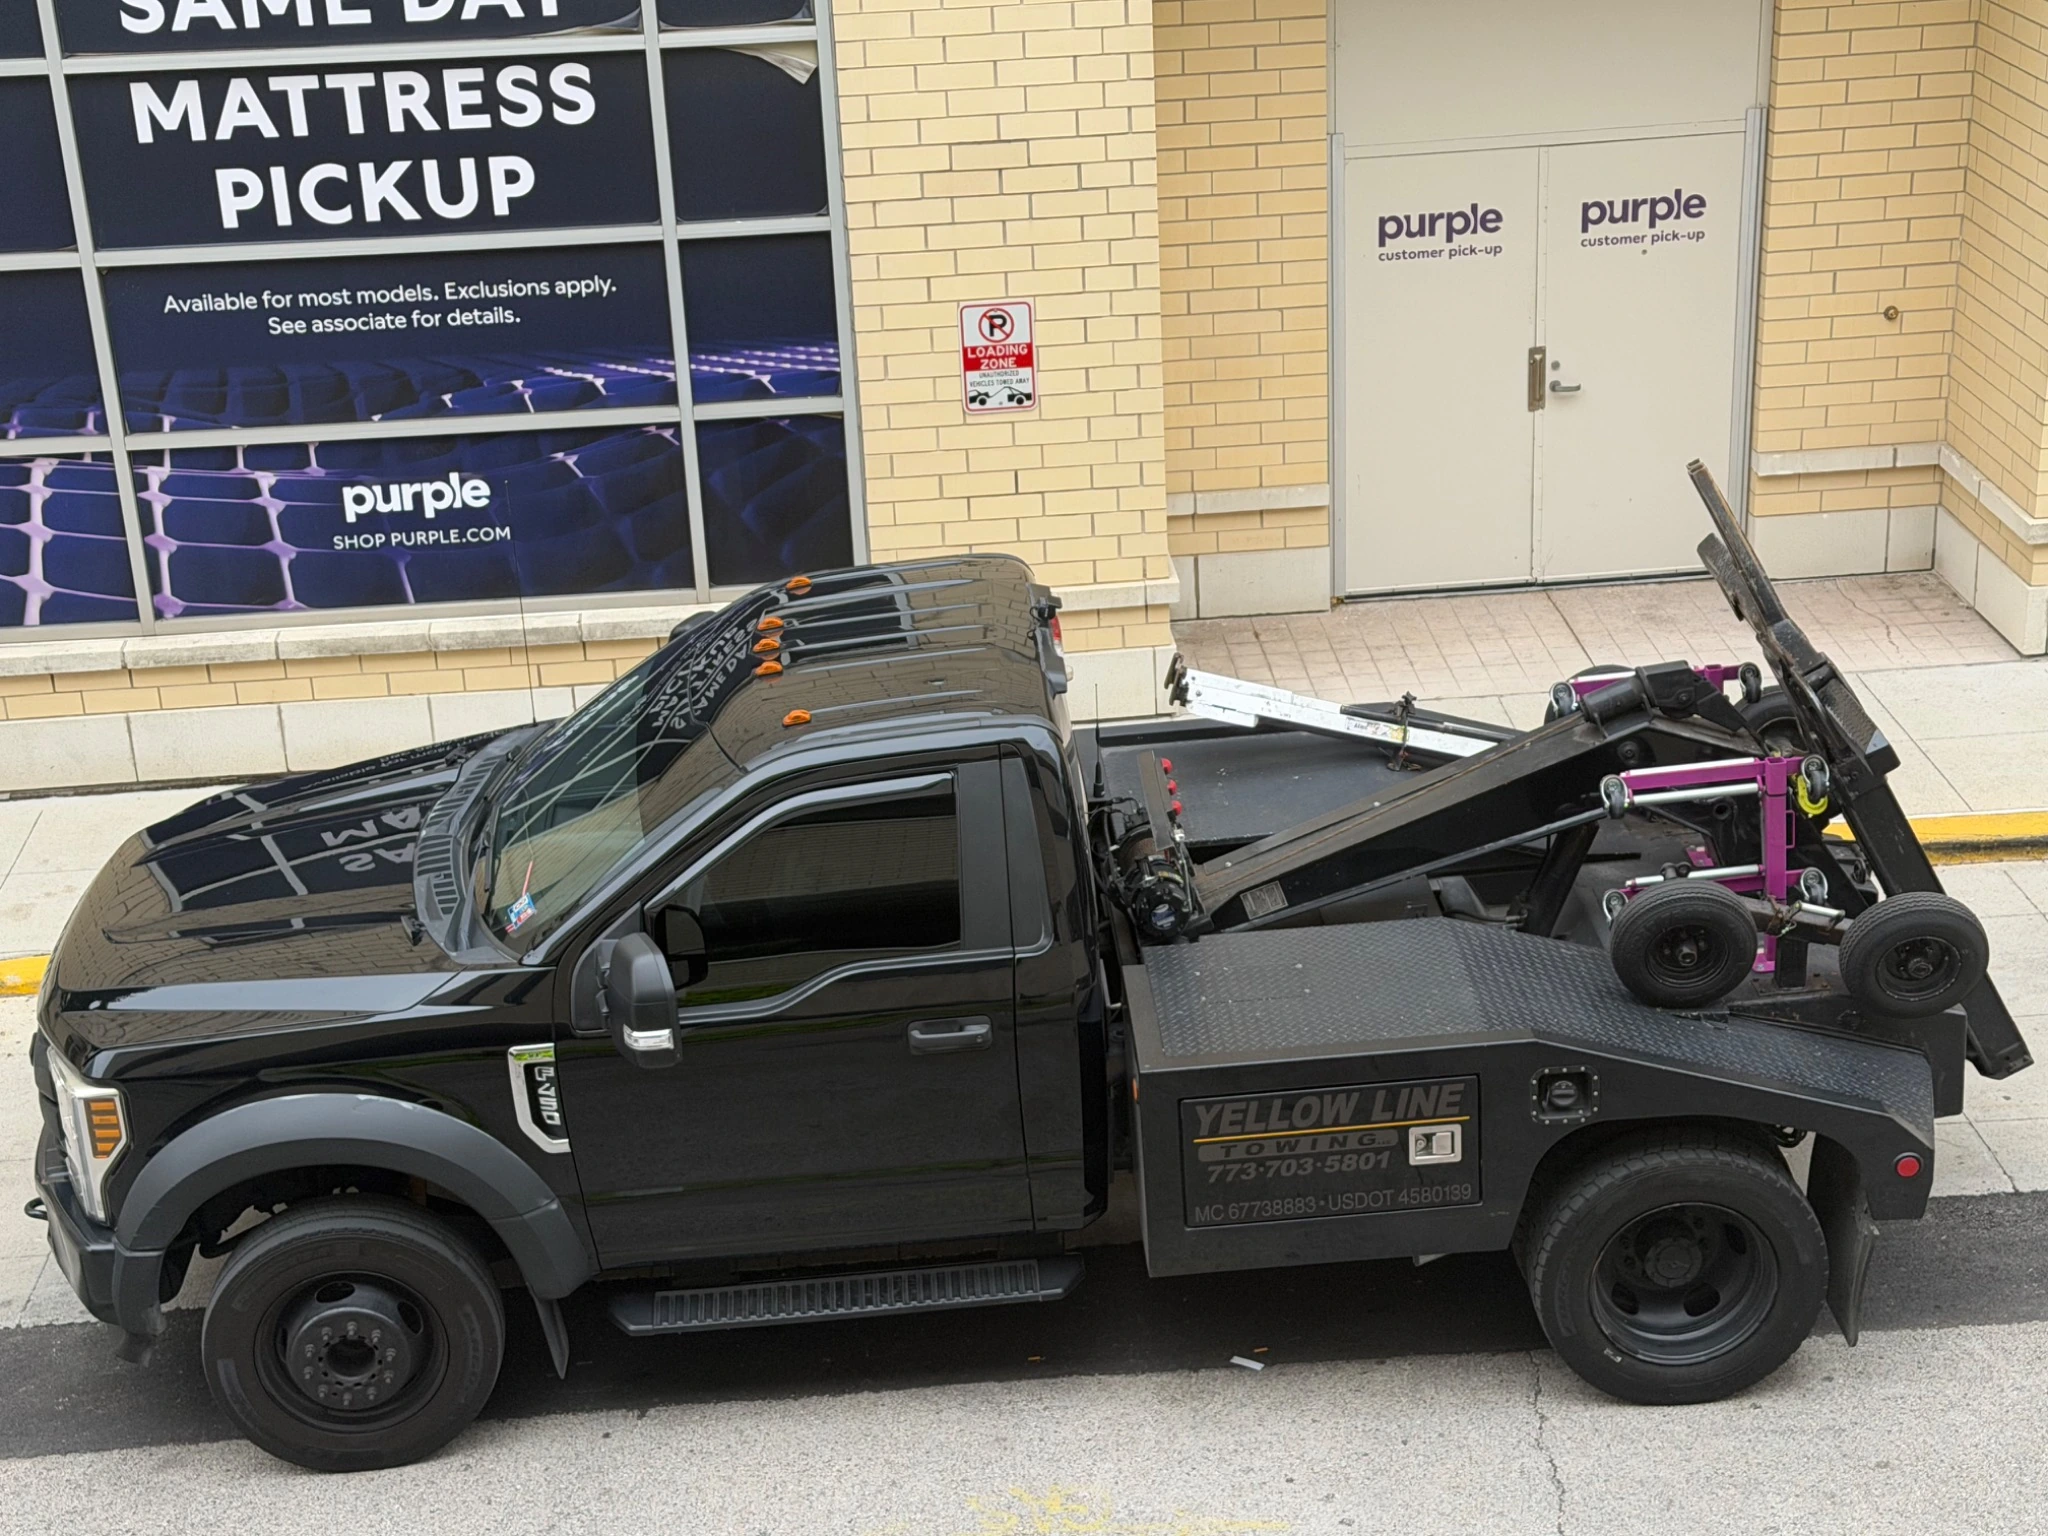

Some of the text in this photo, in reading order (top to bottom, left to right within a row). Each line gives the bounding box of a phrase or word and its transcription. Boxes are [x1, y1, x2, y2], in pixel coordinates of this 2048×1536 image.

[129, 62, 596, 144] MATTRESS
[214, 155, 536, 229] PICKUP
[1378, 203, 1503, 248] purple
[1581, 188, 1707, 234] purple
[1378, 243, 1503, 262] customer pick-up
[1580, 229, 1706, 248] customer pick-up
[163, 275, 618, 314] Available for most models. Exclusions apply.
[267, 306, 522, 335] See associate for details.
[967, 344, 1028, 358] LOADING
[980, 357, 1017, 370] ZONE
[342, 472, 491, 523] purple
[333, 526, 511, 550] SHOP PURPLE.COM
[1195, 1082, 1466, 1137] YELLOW LINE
[1220, 1133, 1377, 1158] TOWING
[1195, 1204, 1224, 1222] MC
[1328, 1189, 1395, 1211] USDOT
